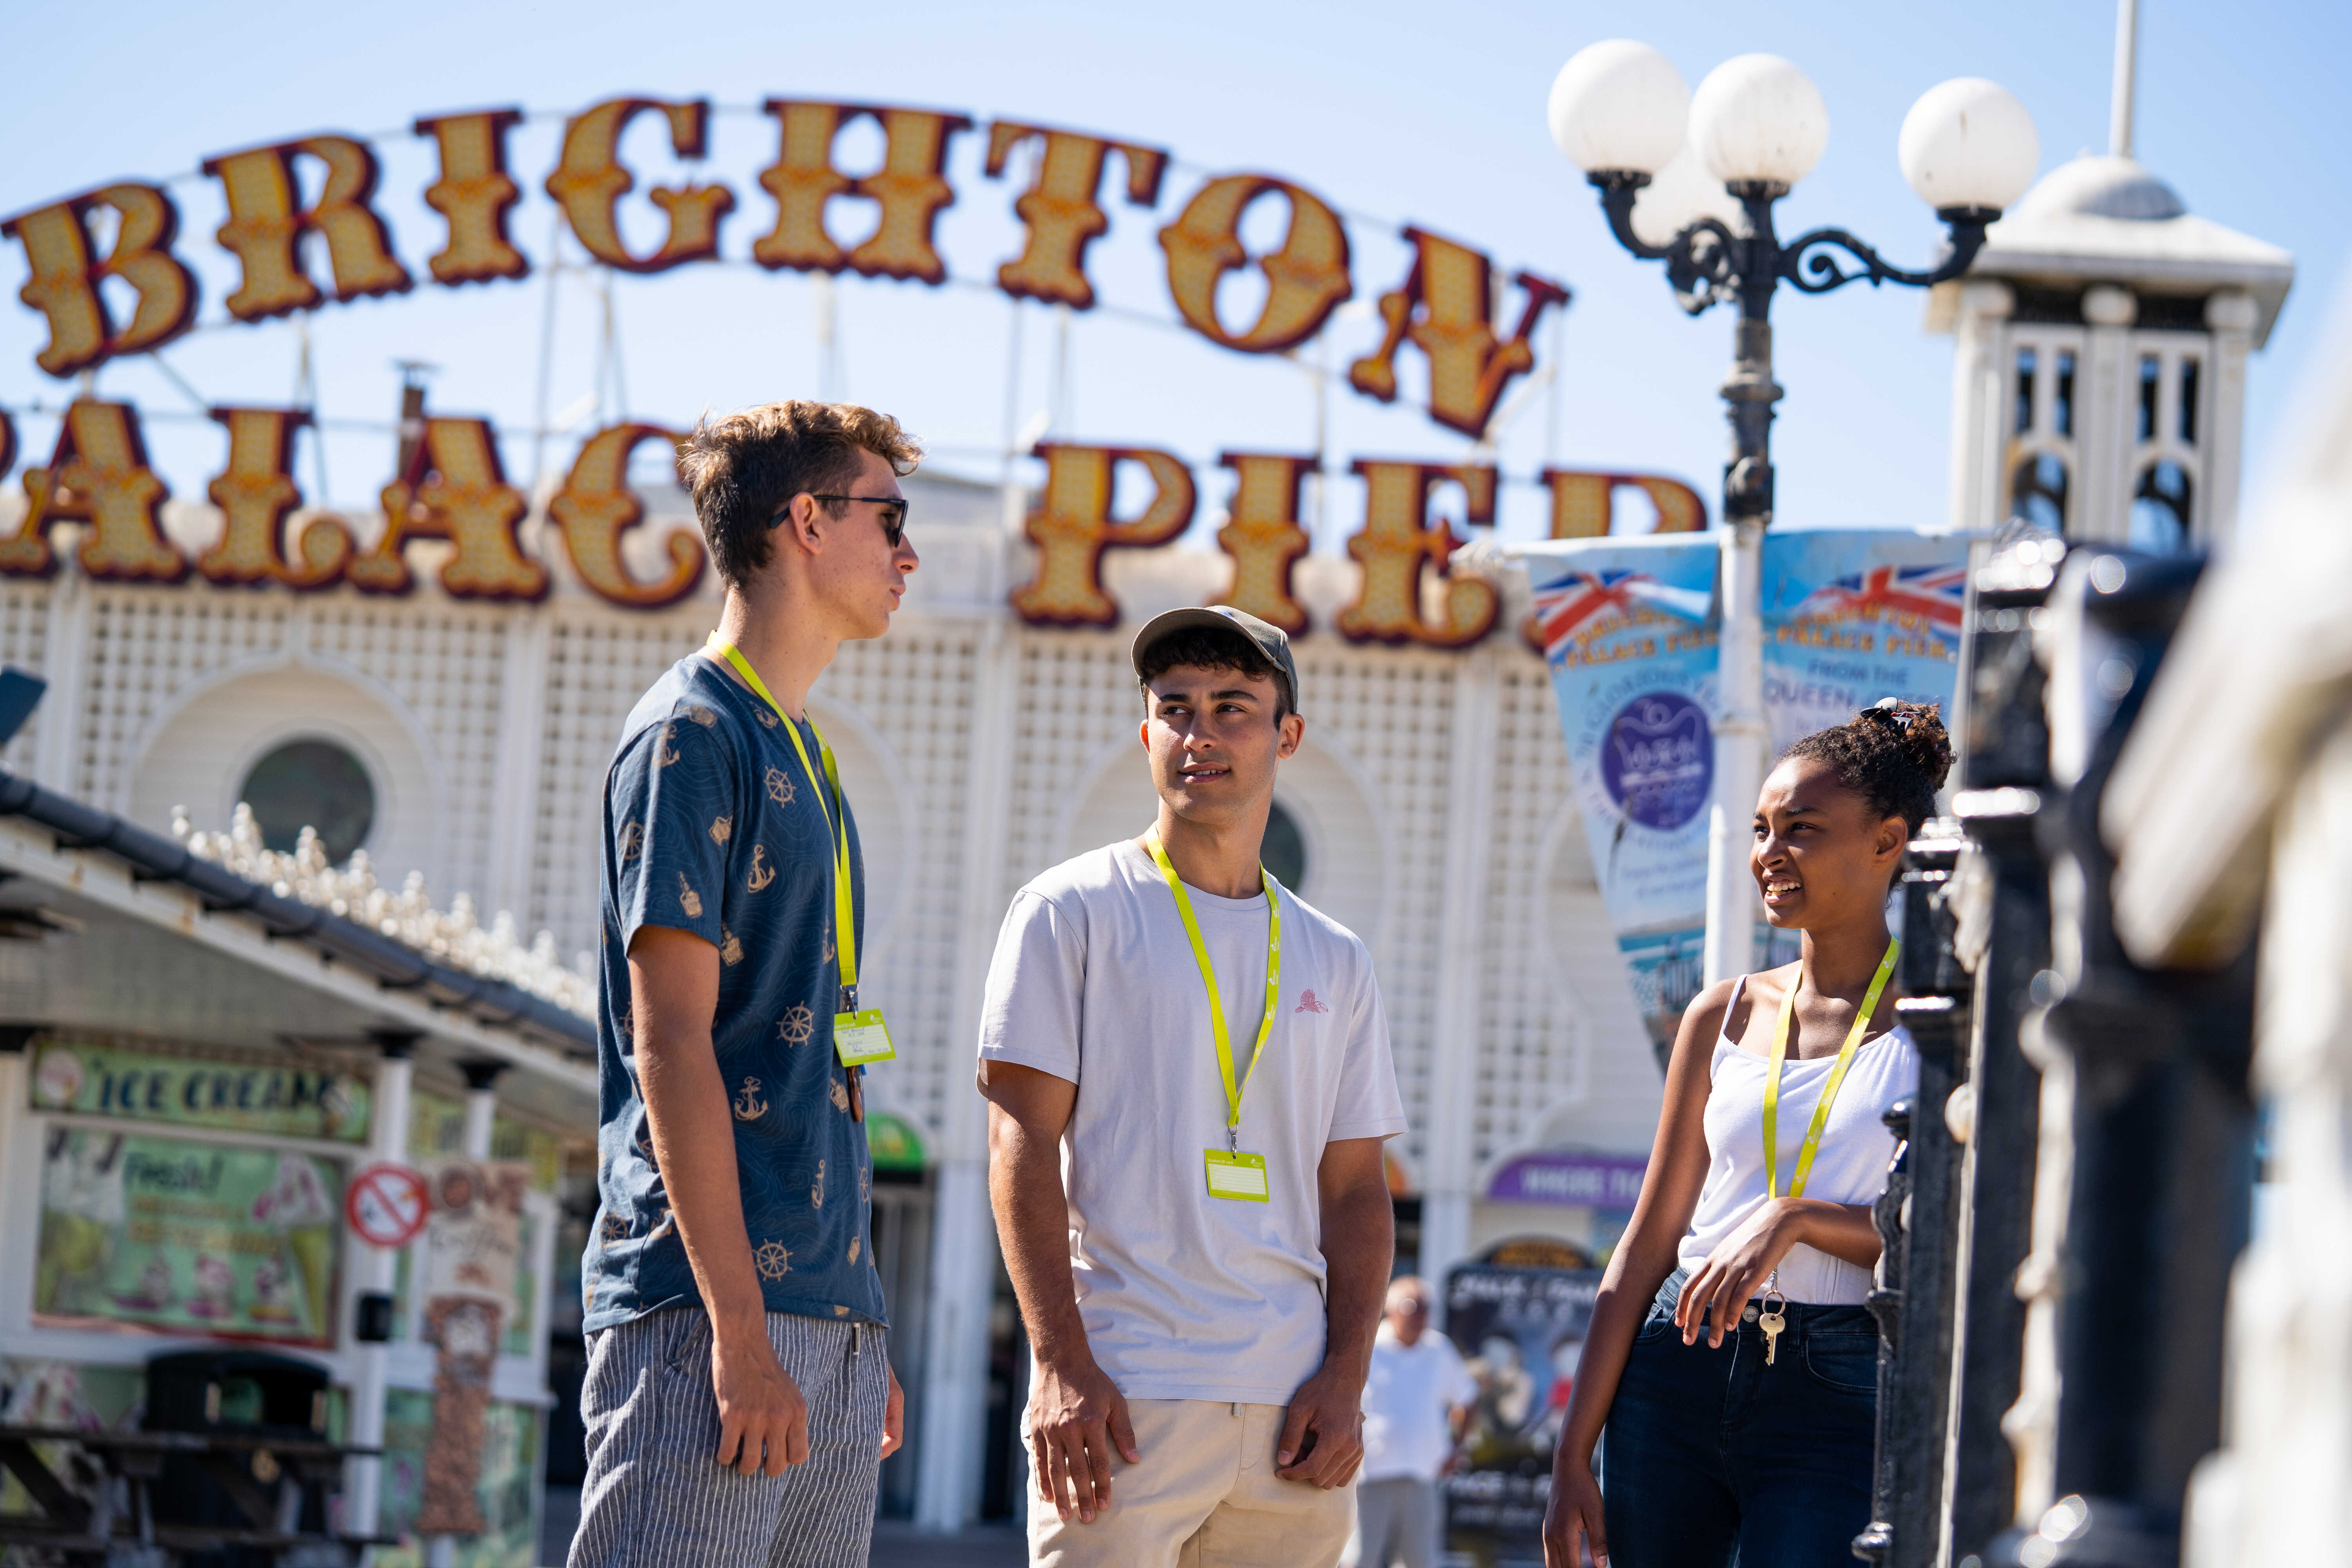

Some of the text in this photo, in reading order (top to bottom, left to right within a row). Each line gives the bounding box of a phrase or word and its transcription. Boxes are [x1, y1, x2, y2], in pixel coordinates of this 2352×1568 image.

[2, 96, 1573, 439] BRIGHTON
[0, 400, 706, 610] ALAC
[1776, 623, 1947, 659] PALACE PIER
[1808, 658, 1910, 684] FROM THE
[98, 1068, 170, 1113] ICE
